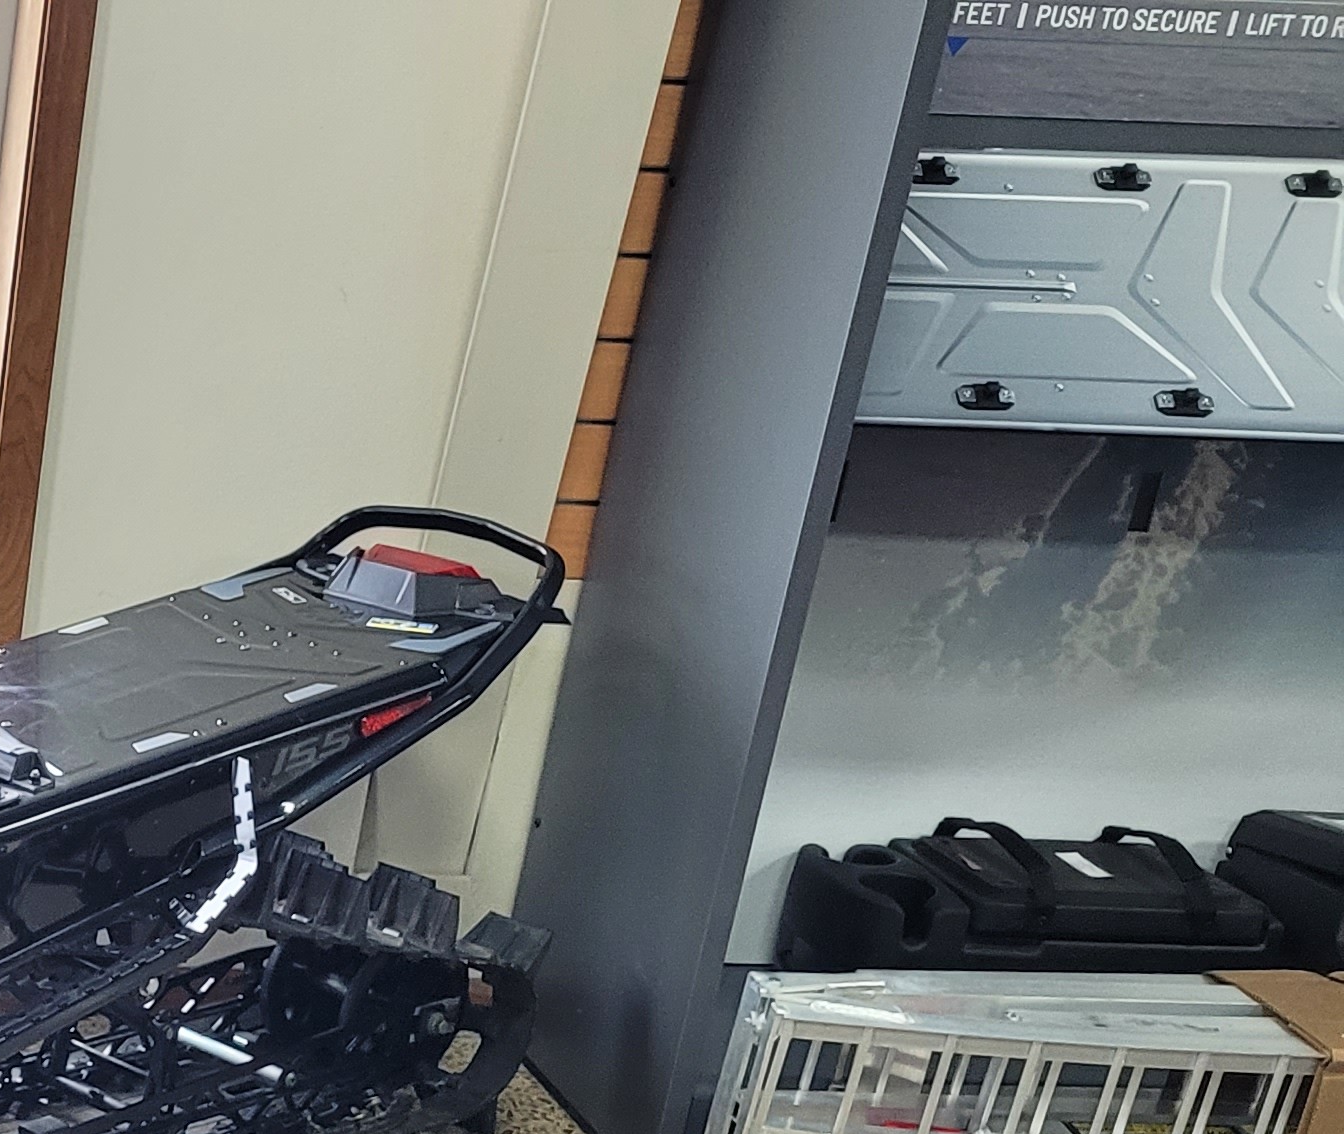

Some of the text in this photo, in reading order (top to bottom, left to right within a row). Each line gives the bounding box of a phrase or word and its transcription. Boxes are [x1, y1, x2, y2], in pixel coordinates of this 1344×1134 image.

[952, 3, 1011, 26] FEET
[1035, 5, 1096, 29] PUSH
[1102, 7, 1129, 31] TO
[1132, 9, 1221, 34] SECURE
[1245, 13, 1296, 37] LIFT
[1300, 15, 1328, 38] TO
